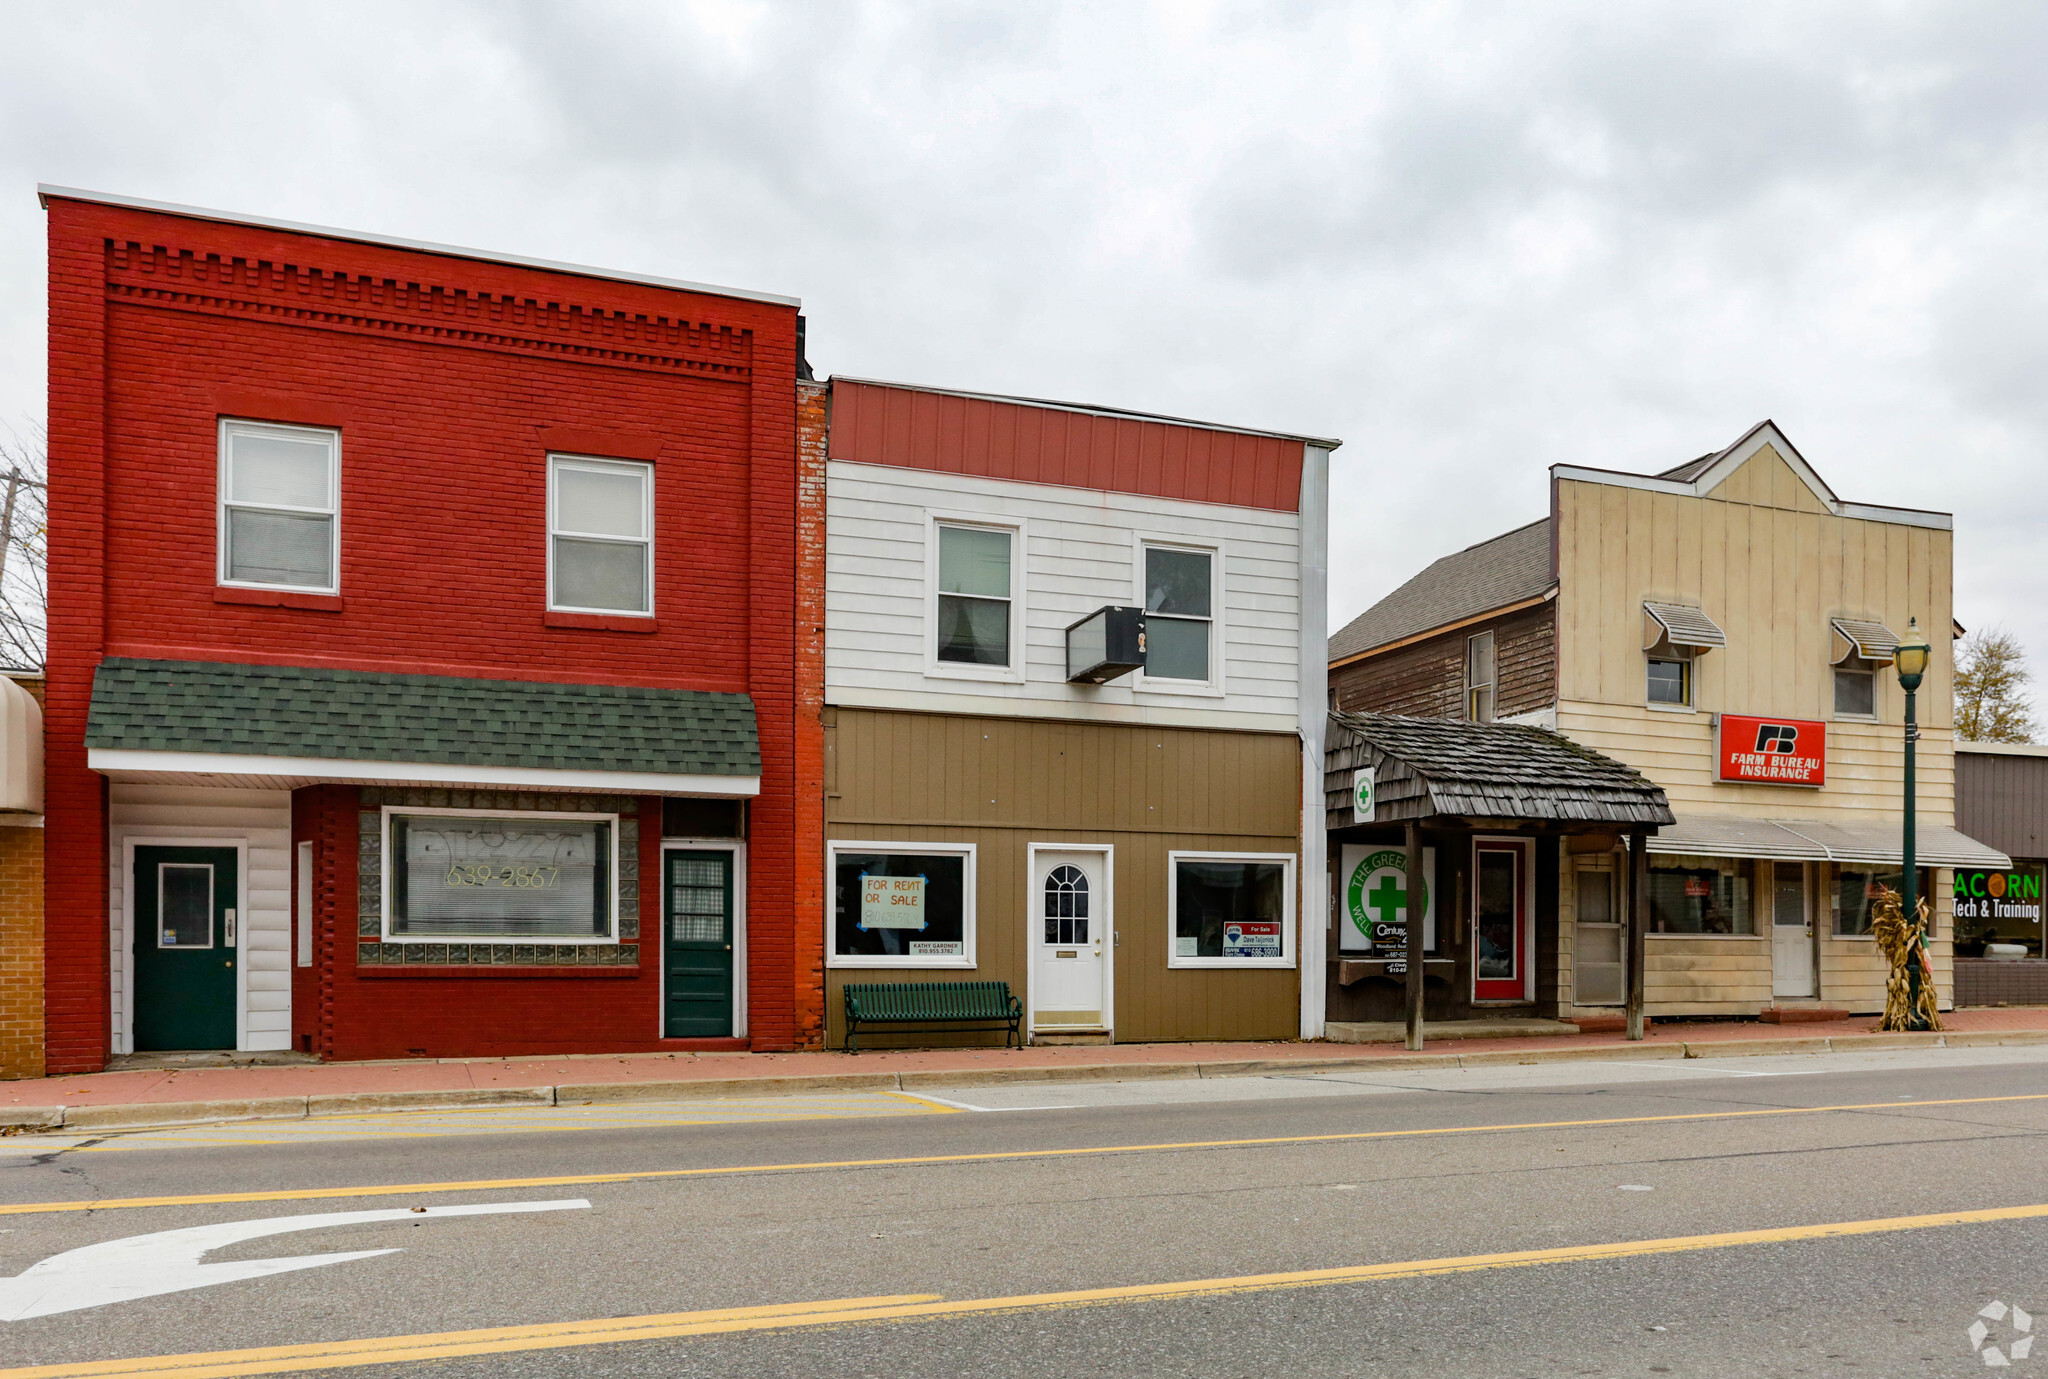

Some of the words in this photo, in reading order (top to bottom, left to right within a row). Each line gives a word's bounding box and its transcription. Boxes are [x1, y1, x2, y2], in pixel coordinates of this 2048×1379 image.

[1731, 753, 1766, 766] FARM
[1771, 755, 1820, 770] BUREAU
[1740, 765, 1811, 780] INSURANCE
[446, 865, 558, 888] 639-2867
[1352, 862, 1372, 888] THE
[1953, 872, 2040, 898] ACORN
[868, 880, 888, 891] FOR
[894, 880, 922, 892] RENT
[865, 893, 881, 904] OR
[891, 895, 917, 906] SALE
[1352, 904, 1373, 936] WELL
[1952, 897, 1977, 918] Tech
[1980, 899, 1990, 918] &
[1993, 898, 2039, 923] Training
[1377, 924, 1406, 937] Century
